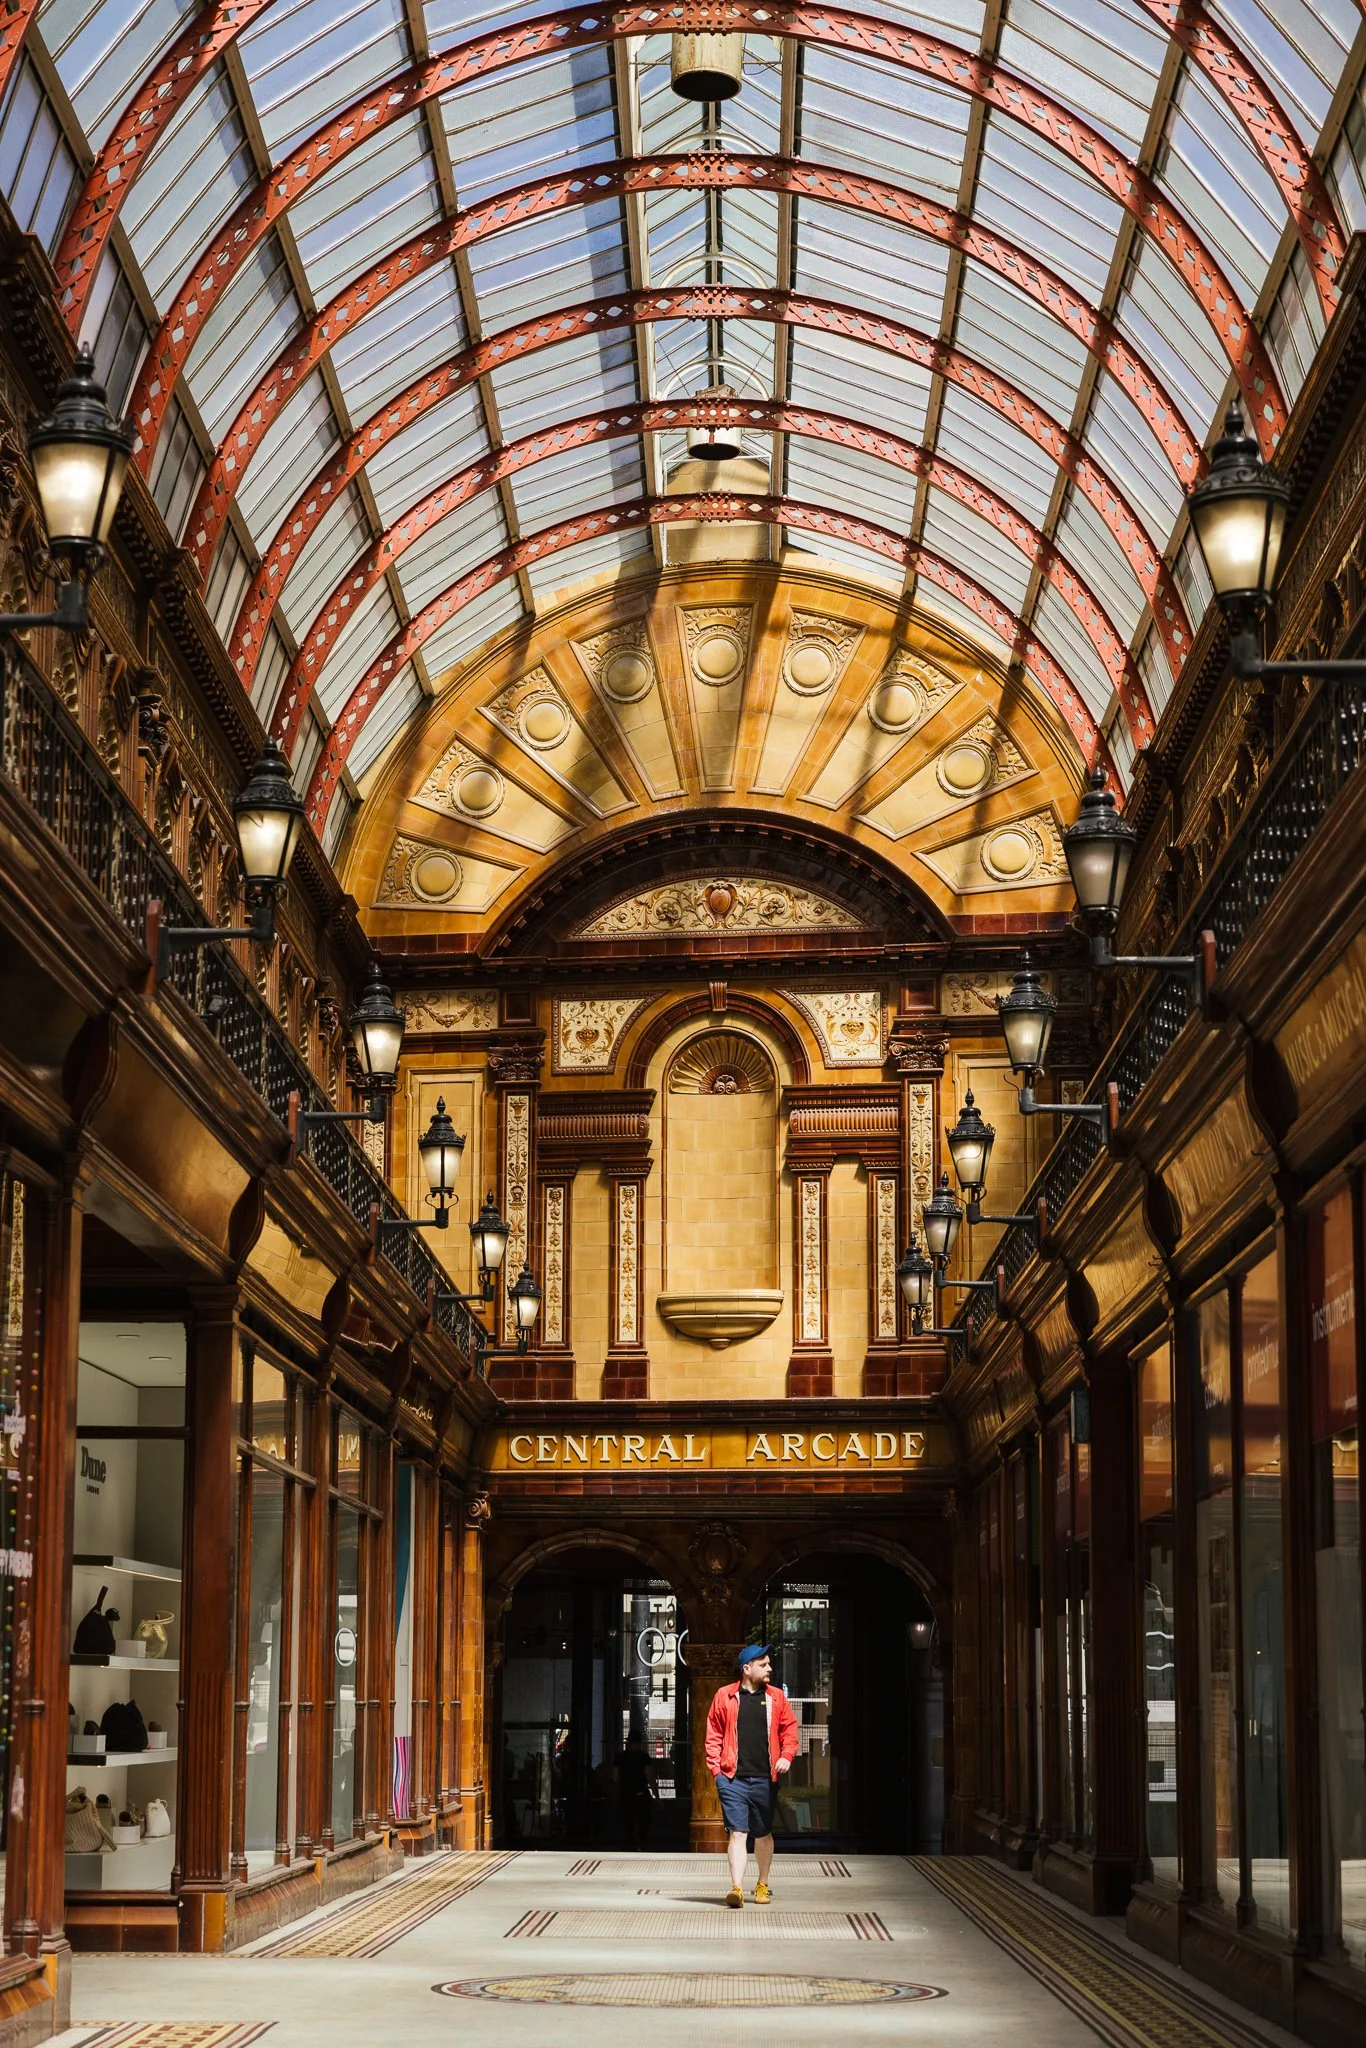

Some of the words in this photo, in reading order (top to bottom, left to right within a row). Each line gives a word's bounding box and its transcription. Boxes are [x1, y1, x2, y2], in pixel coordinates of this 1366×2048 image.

[1283, 1023, 1320, 1091] MUSIC
[81, 1445, 107, 1484] Dune
[509, 1433, 707, 1464] CENTRAL
[746, 1431, 926, 1461] ARCADE
